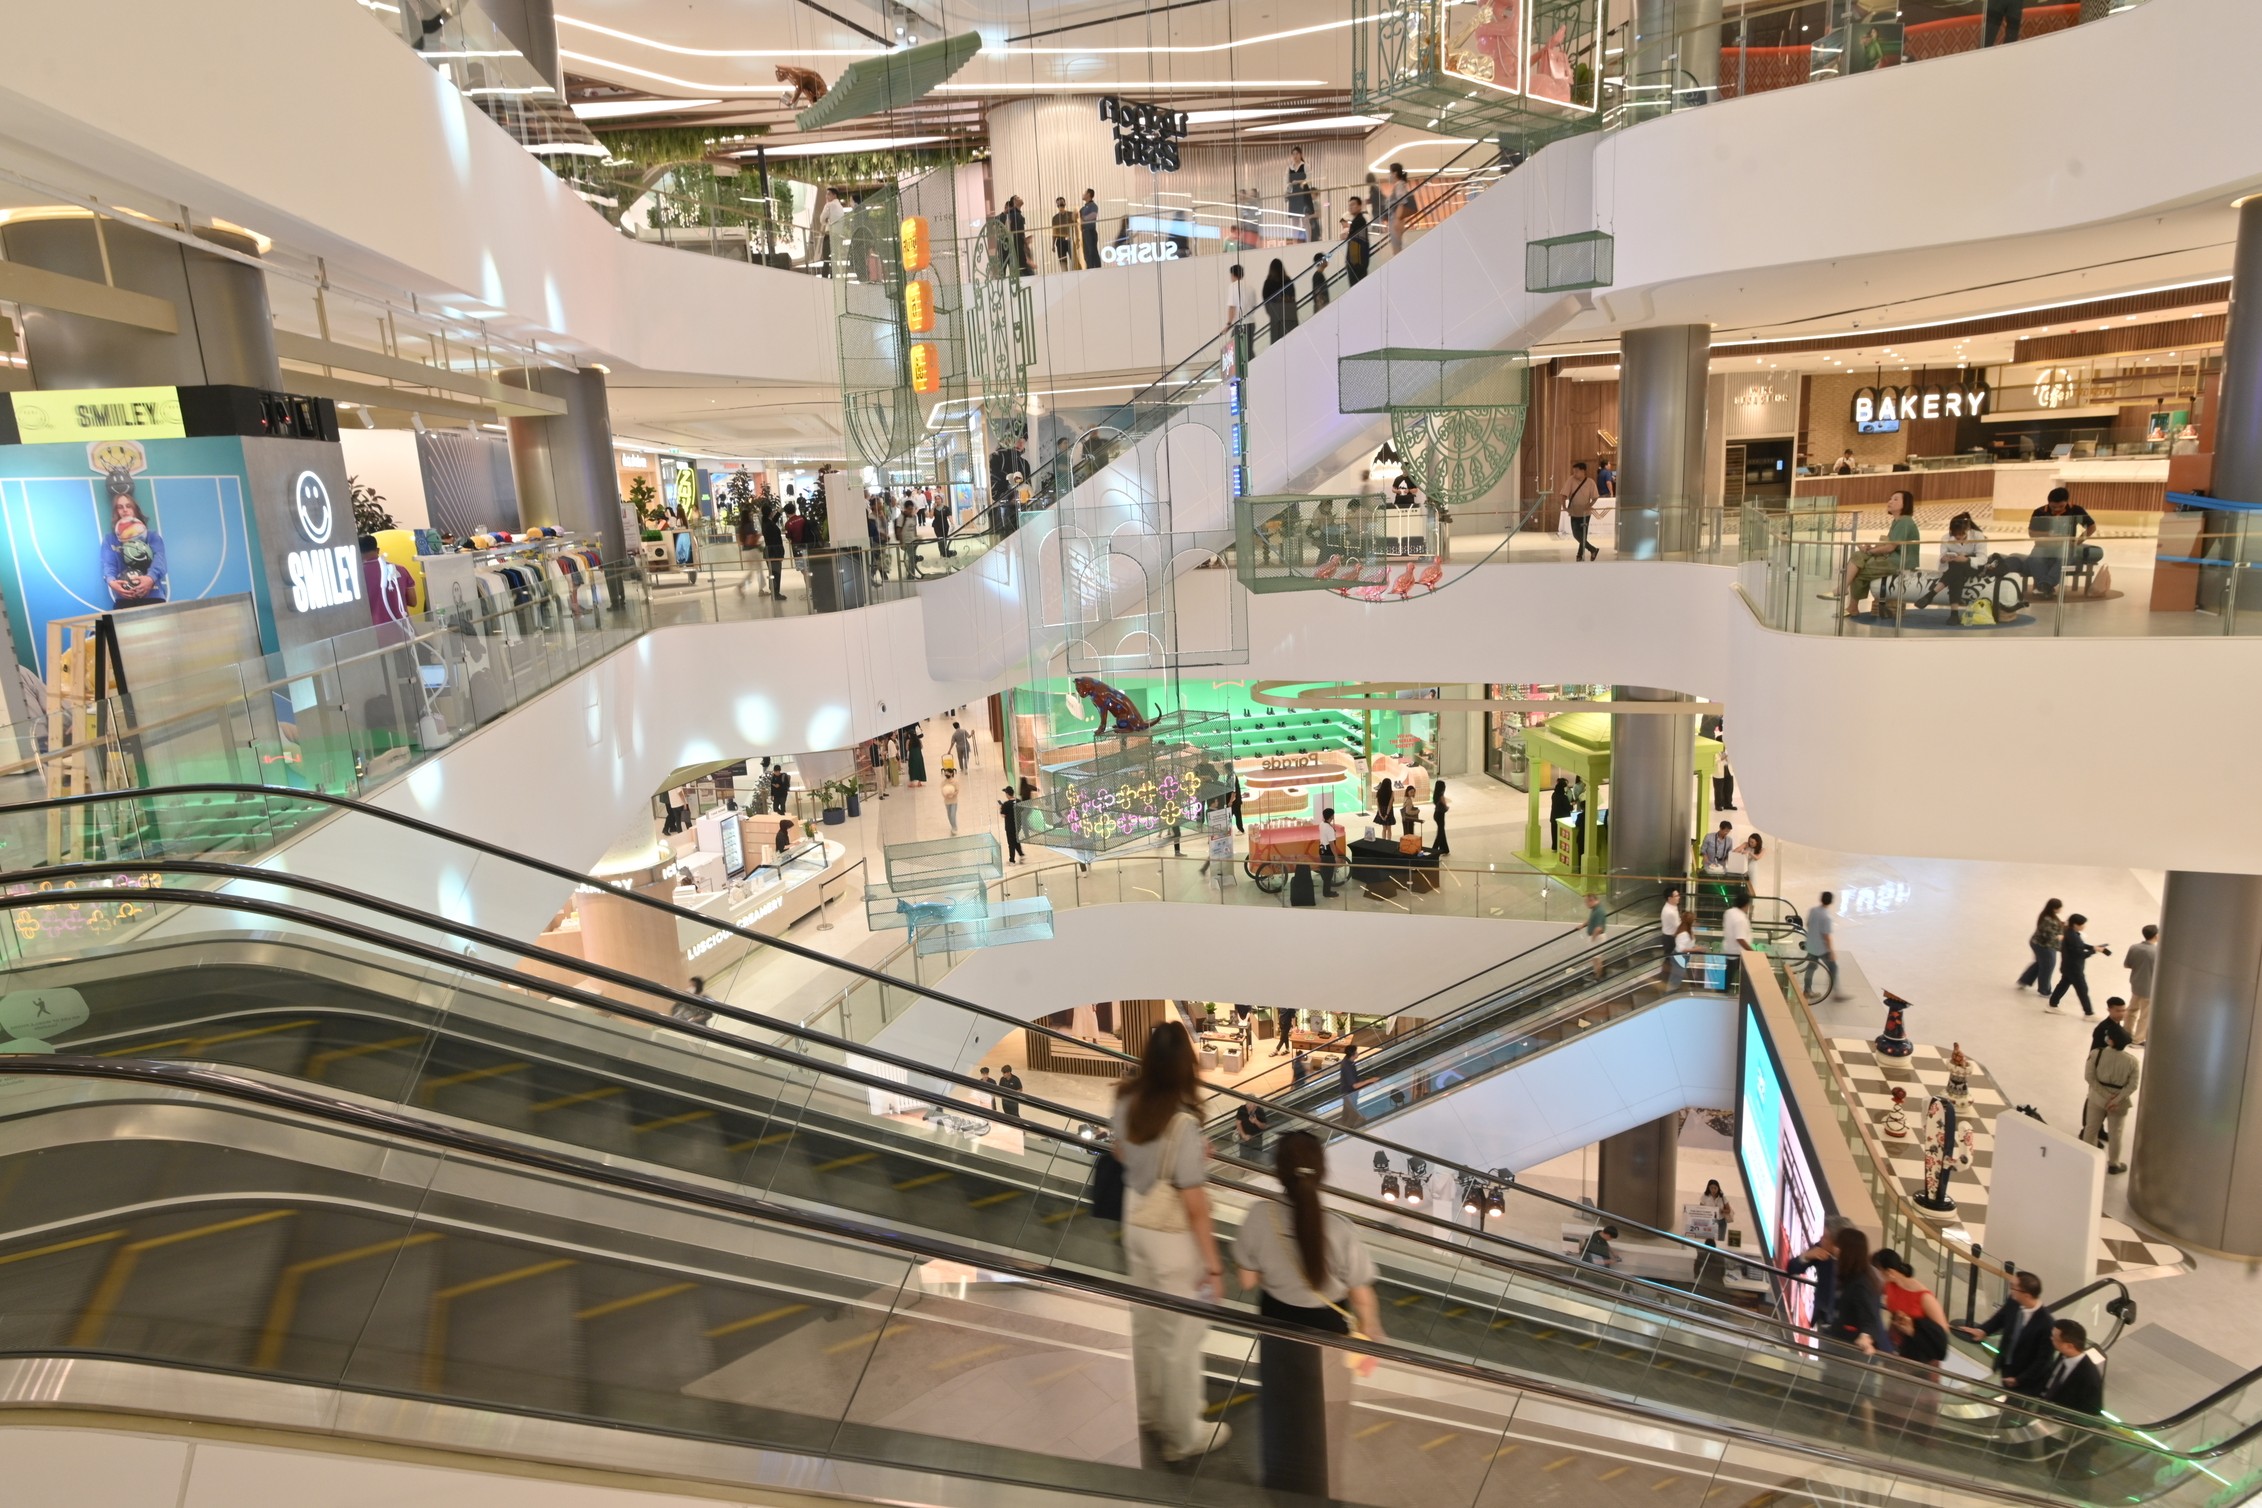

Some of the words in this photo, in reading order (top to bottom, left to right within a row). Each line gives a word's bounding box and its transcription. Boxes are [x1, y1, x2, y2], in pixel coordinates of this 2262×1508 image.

[74, 402, 156, 428] SMILEY
[1855, 391, 1985, 422] BAKERY
[286, 545, 362, 613] SMILEY
